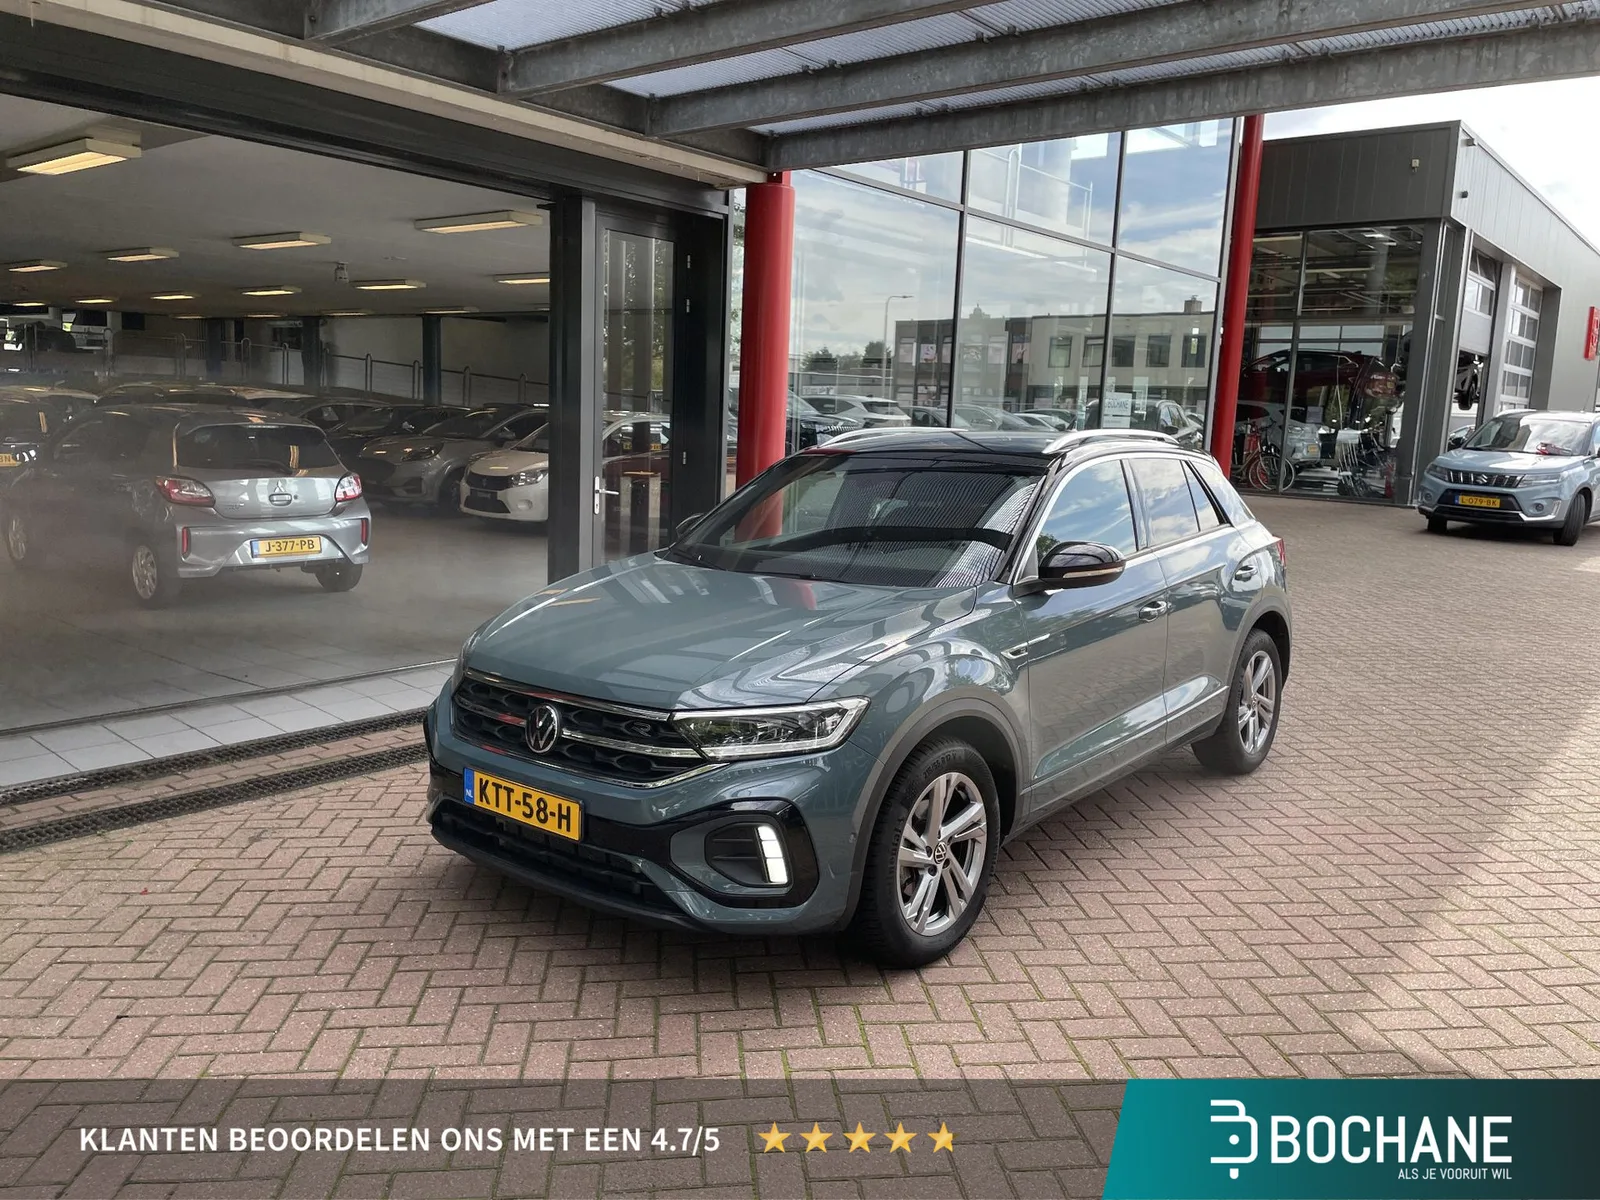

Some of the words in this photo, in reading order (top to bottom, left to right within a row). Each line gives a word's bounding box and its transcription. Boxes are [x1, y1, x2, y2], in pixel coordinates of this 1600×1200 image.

[1461, 496, 1497, 506] L-079-BK
[265, 540, 315, 552] J-377-PB
[465, 789, 474, 798] NL
[479, 777, 571, 832] KTT-58-H
